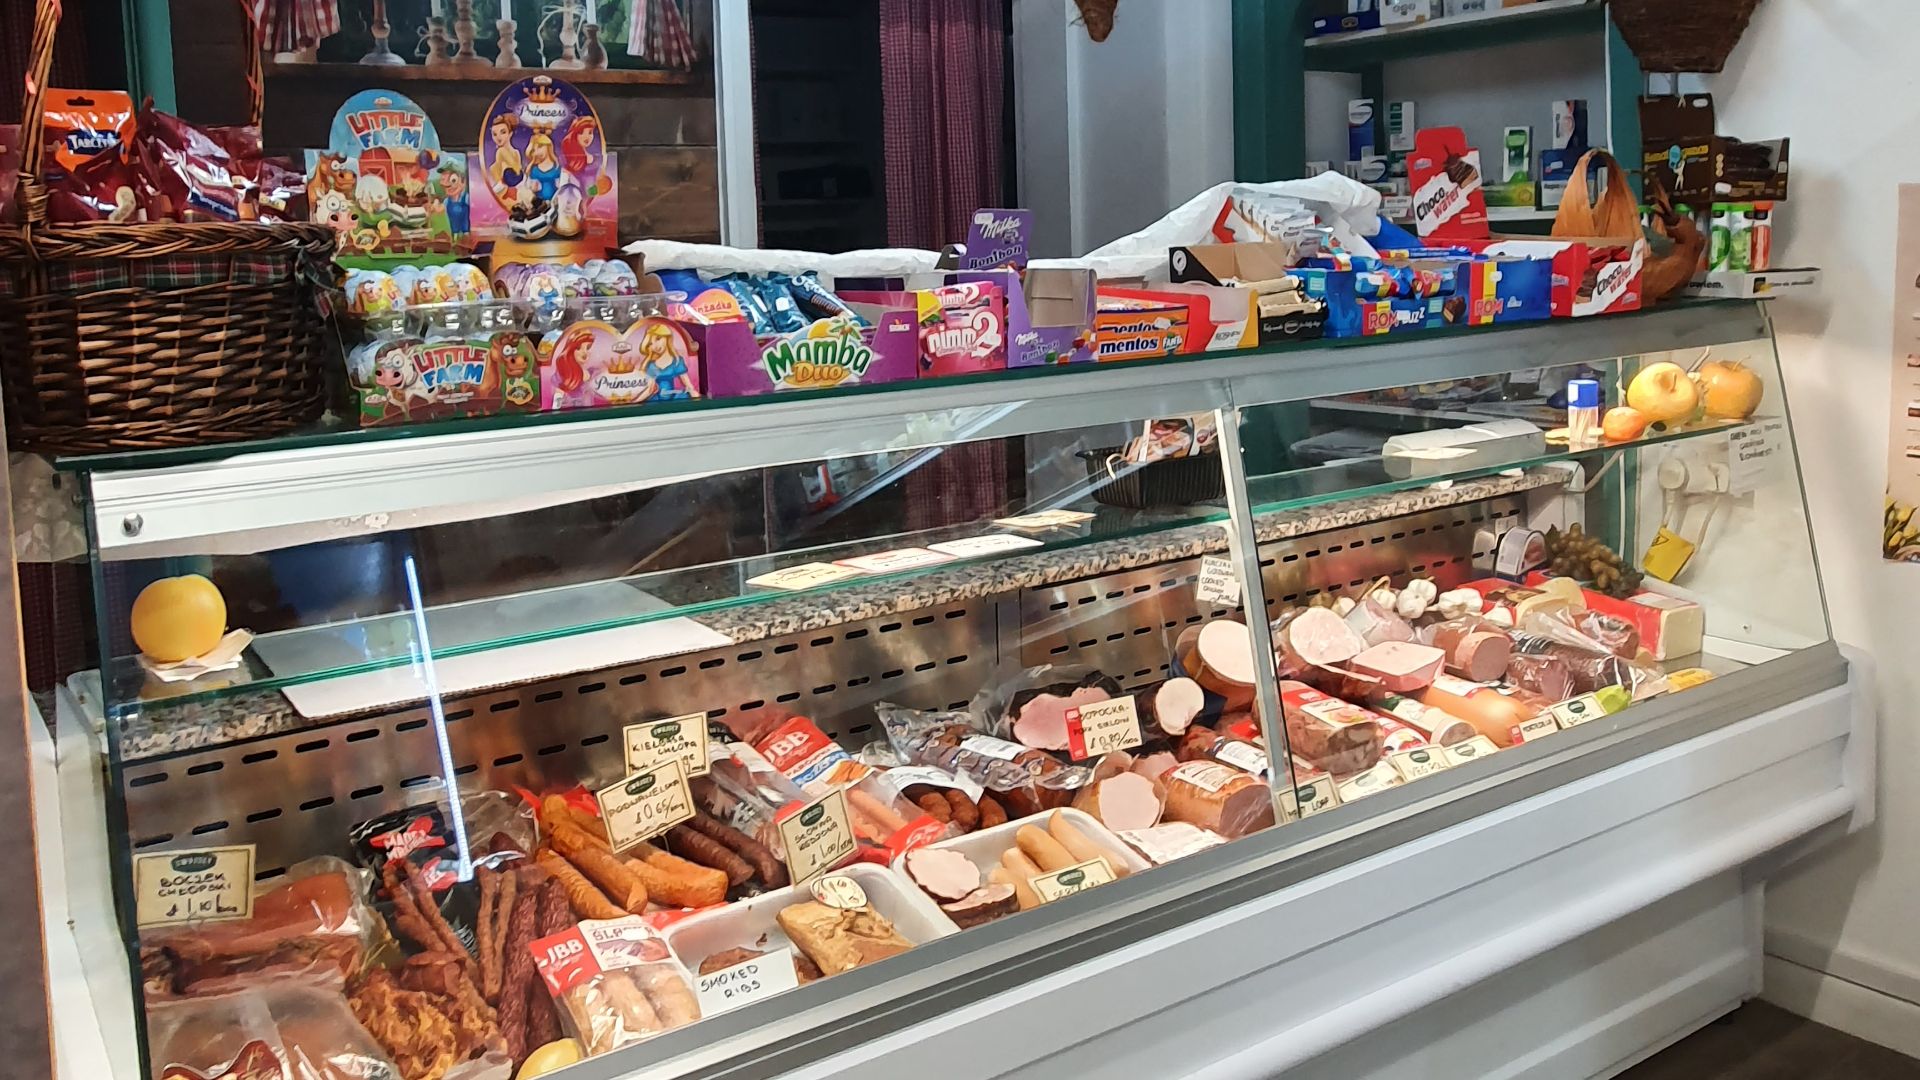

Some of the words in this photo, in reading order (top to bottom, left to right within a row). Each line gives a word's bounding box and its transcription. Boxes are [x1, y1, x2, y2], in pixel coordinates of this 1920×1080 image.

[519, 102, 566, 117] Princess
[347, 111, 425, 134] LITTLE
[1417, 186, 1446, 221] Choco
[1475, 299, 1503, 315] ROM
[1368, 311, 1399, 329] ROM
[927, 311, 1002, 358] nimm2
[1100, 337, 1158, 353] mentos
[413, 347, 487, 373] LITTLE
[766, 333, 872, 381] Mamba
[423, 363, 484, 387] FARM
[594, 375, 648, 390] Princess
[793, 363, 843, 382] Duo
[546, 939, 584, 965] JBB
[701, 964, 759, 992] SMOKED
[724, 980, 761, 998] RIBS
